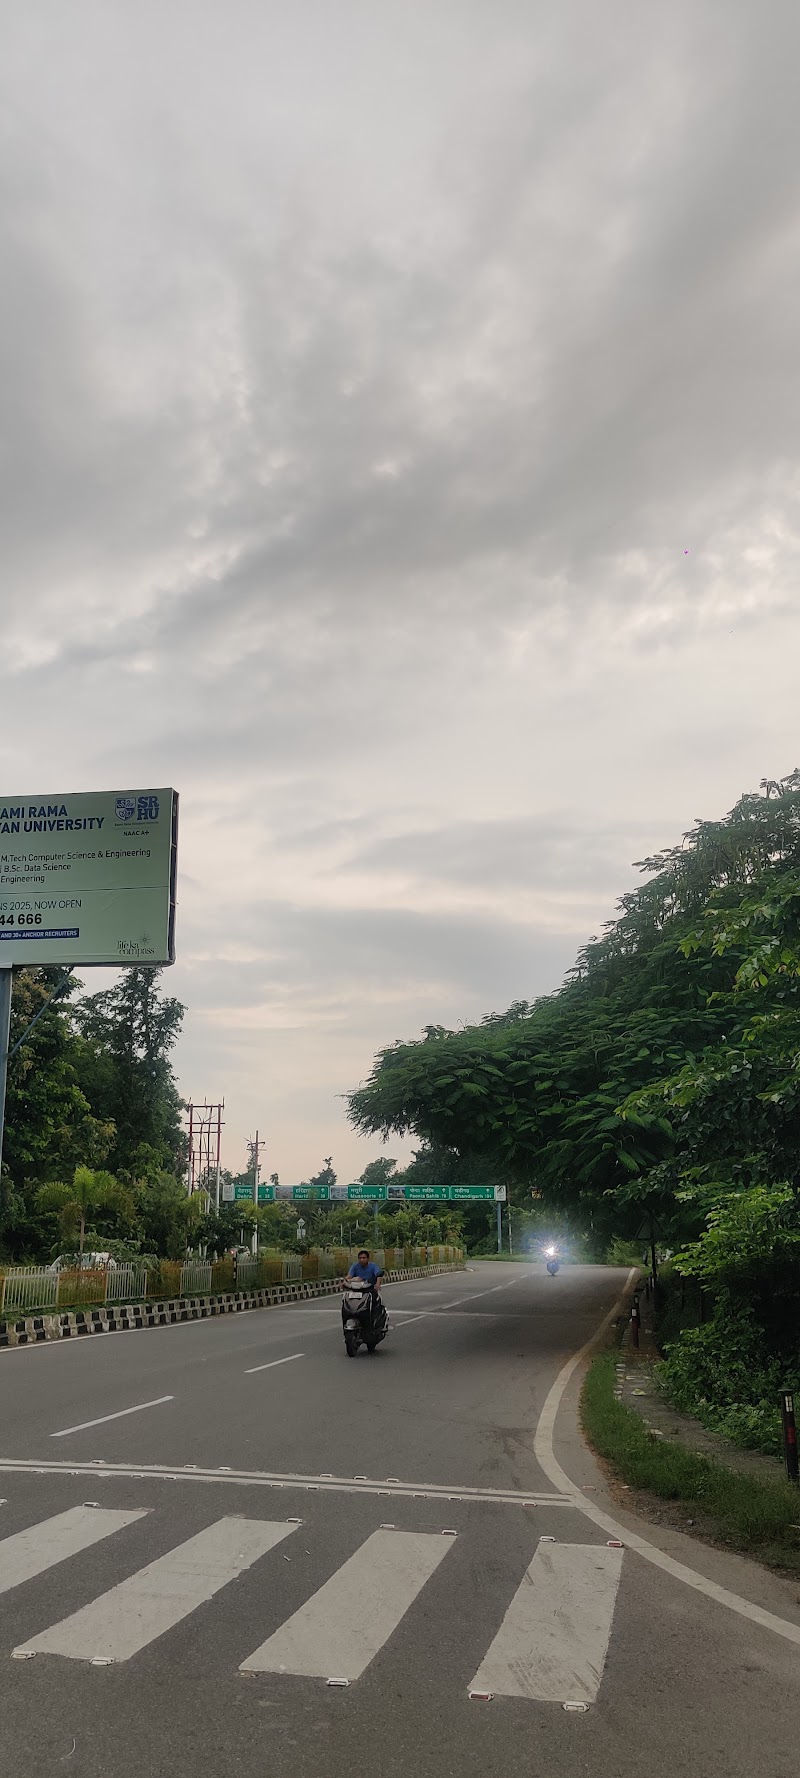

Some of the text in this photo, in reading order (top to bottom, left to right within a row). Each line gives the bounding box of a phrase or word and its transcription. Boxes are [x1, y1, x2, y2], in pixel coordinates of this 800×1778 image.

[0, 805, 68, 819] AMI RAMA
[0, 821, 20, 833] AN
[24, 817, 105, 832] UNIVERSITY
[1, 848, 151, 862] M.Tech Computer Science & Engineering
[4, 864, 22, 872] B.Sc.
[43, 862, 71, 871] Science
[1, 874, 45, 884] Engineering
[34, 900, 57, 909] NOW
[59, 899, 82, 908] OPEN
[18, 913, 42, 925] 666
[119, 948, 154, 957] compass
